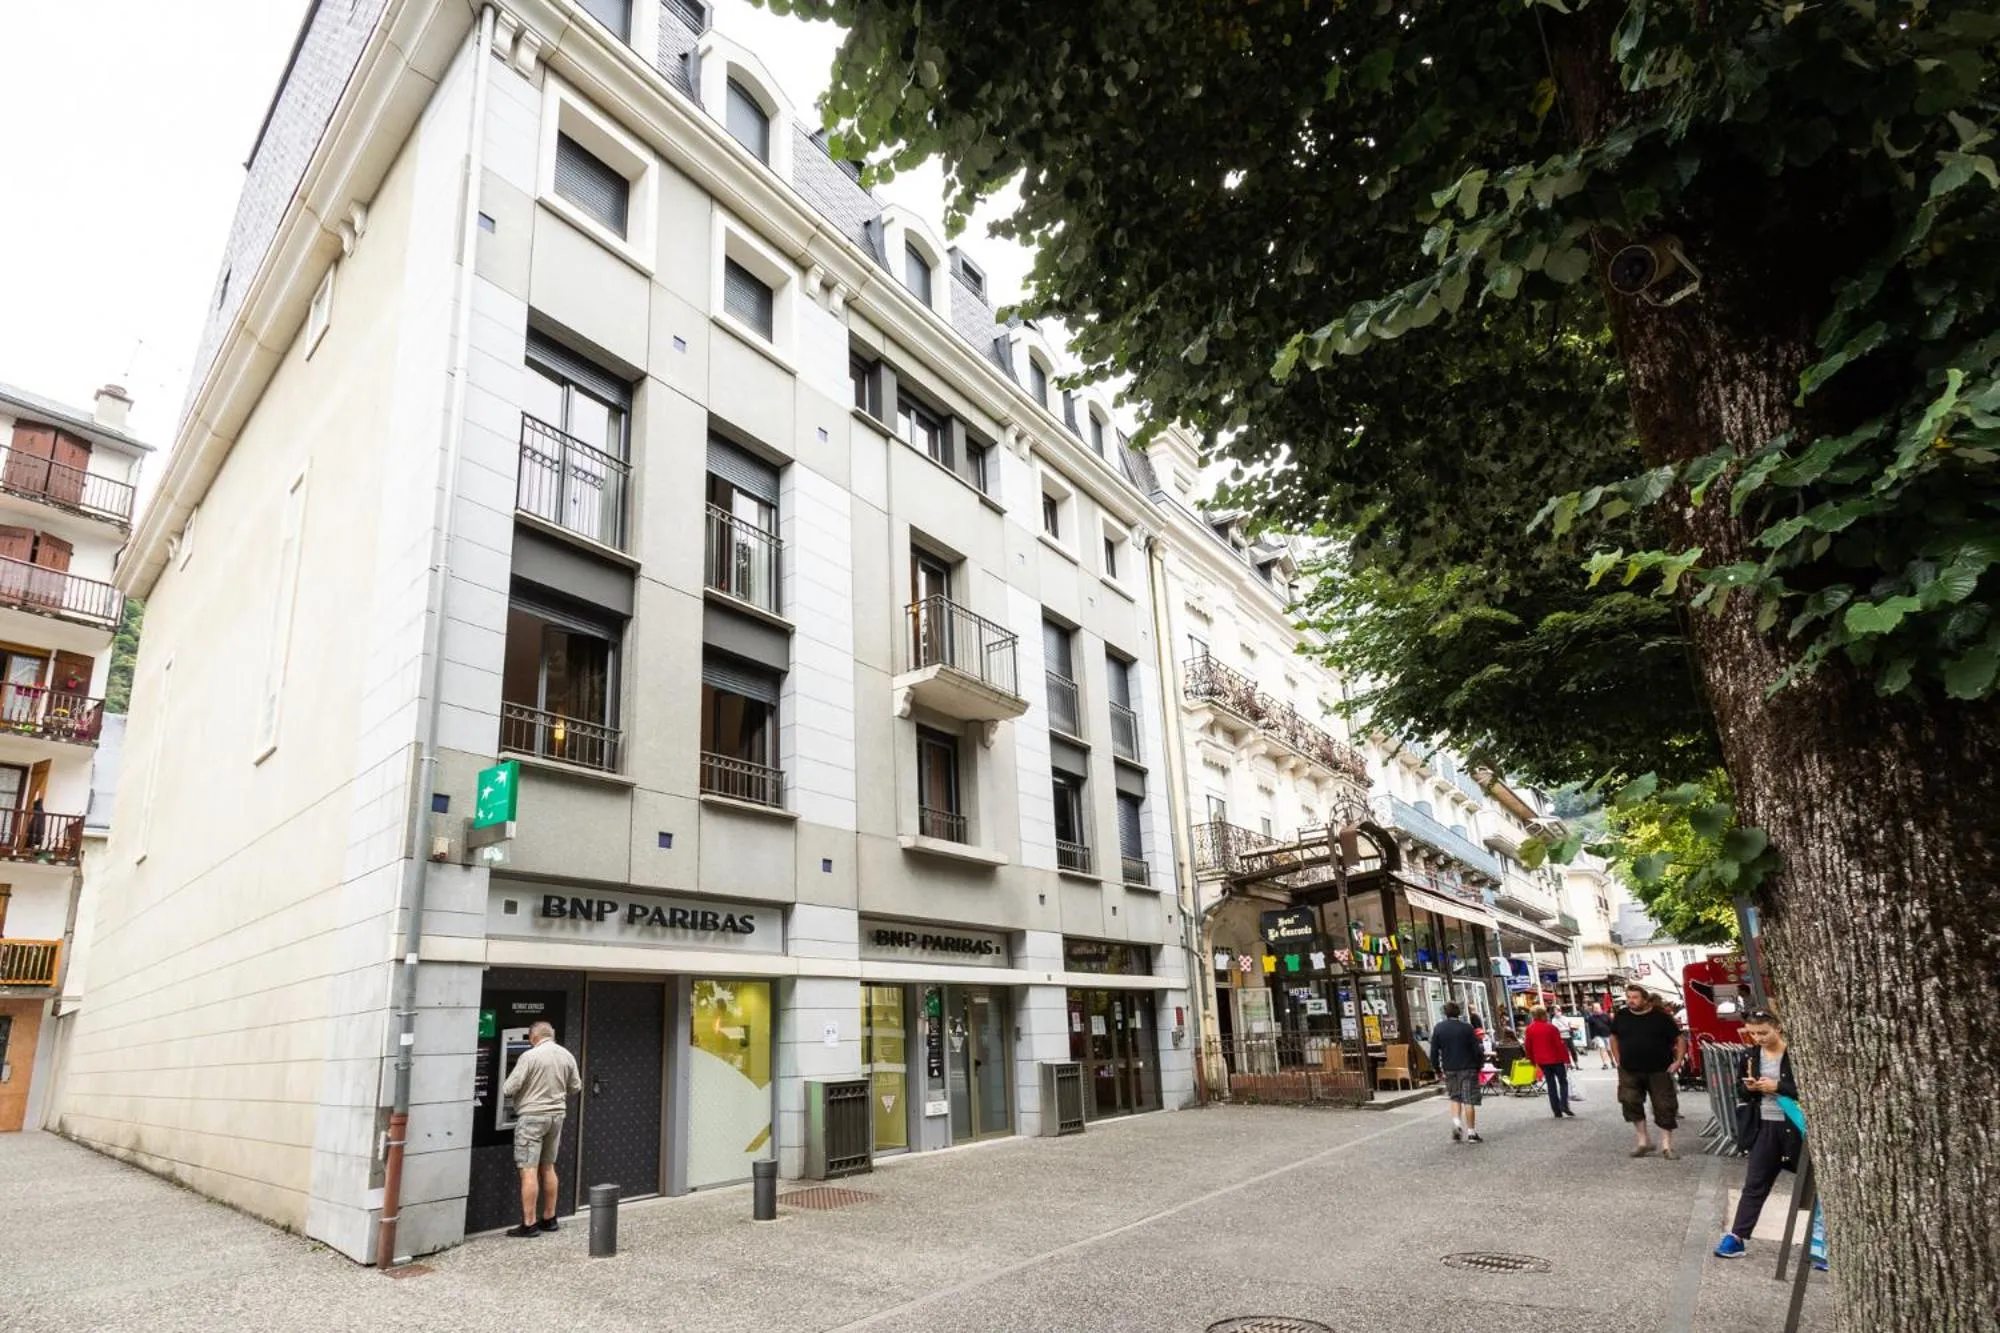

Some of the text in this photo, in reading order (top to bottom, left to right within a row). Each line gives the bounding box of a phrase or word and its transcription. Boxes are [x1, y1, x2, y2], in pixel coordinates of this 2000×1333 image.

[542, 895, 755, 934] BNP PARIBAS
[875, 929, 993, 955] BNP PARIBAS
[1343, 999, 1388, 1017] BAR
